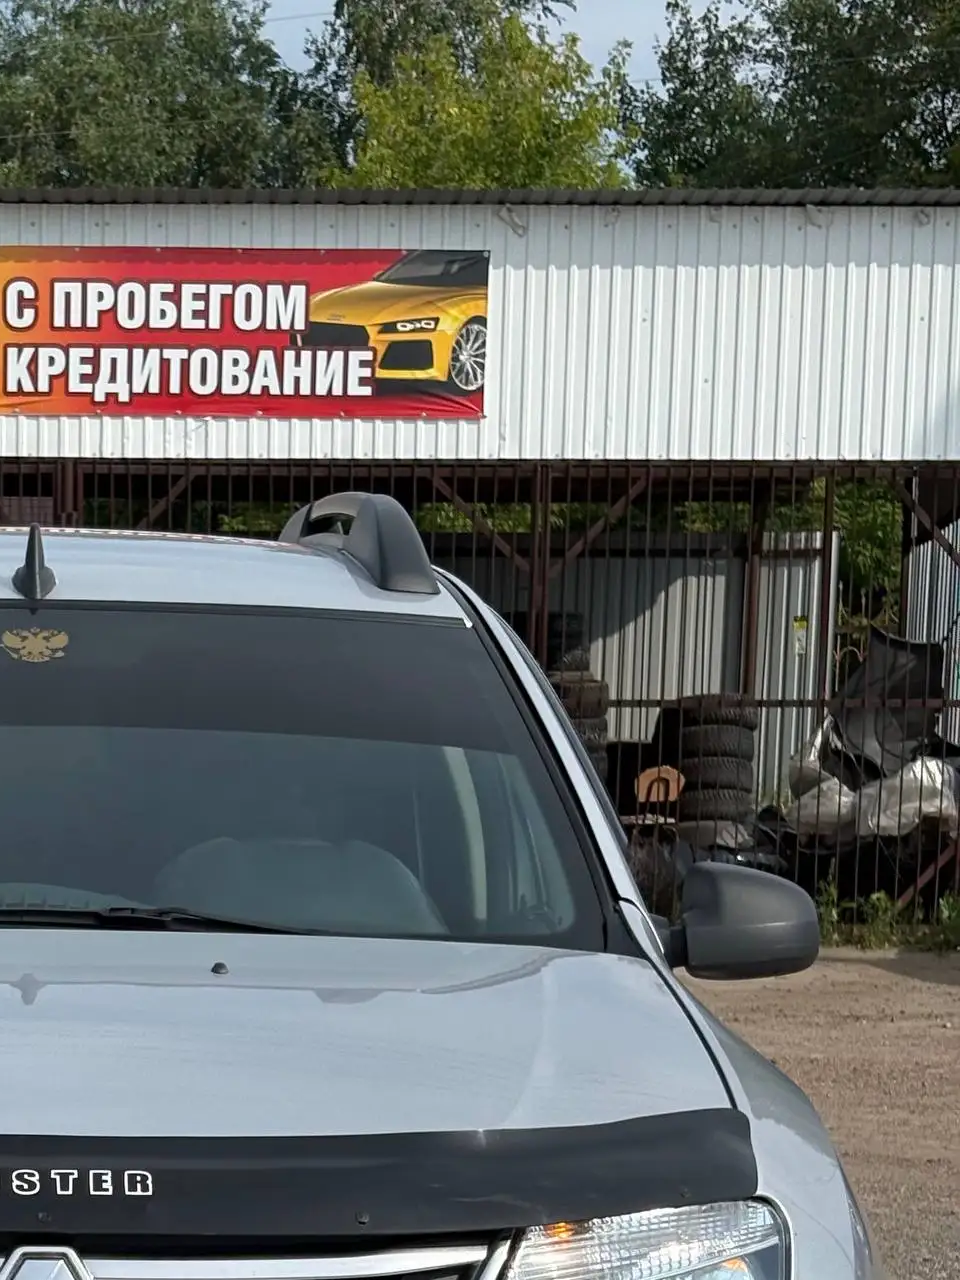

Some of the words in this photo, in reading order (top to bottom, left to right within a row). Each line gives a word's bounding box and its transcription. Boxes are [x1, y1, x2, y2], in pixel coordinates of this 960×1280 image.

[4, 280, 36, 328] С
[53, 281, 307, 331] ПРОБЕГОМ
[5, 346, 374, 404] КРЕДИТОВАНИЕ
